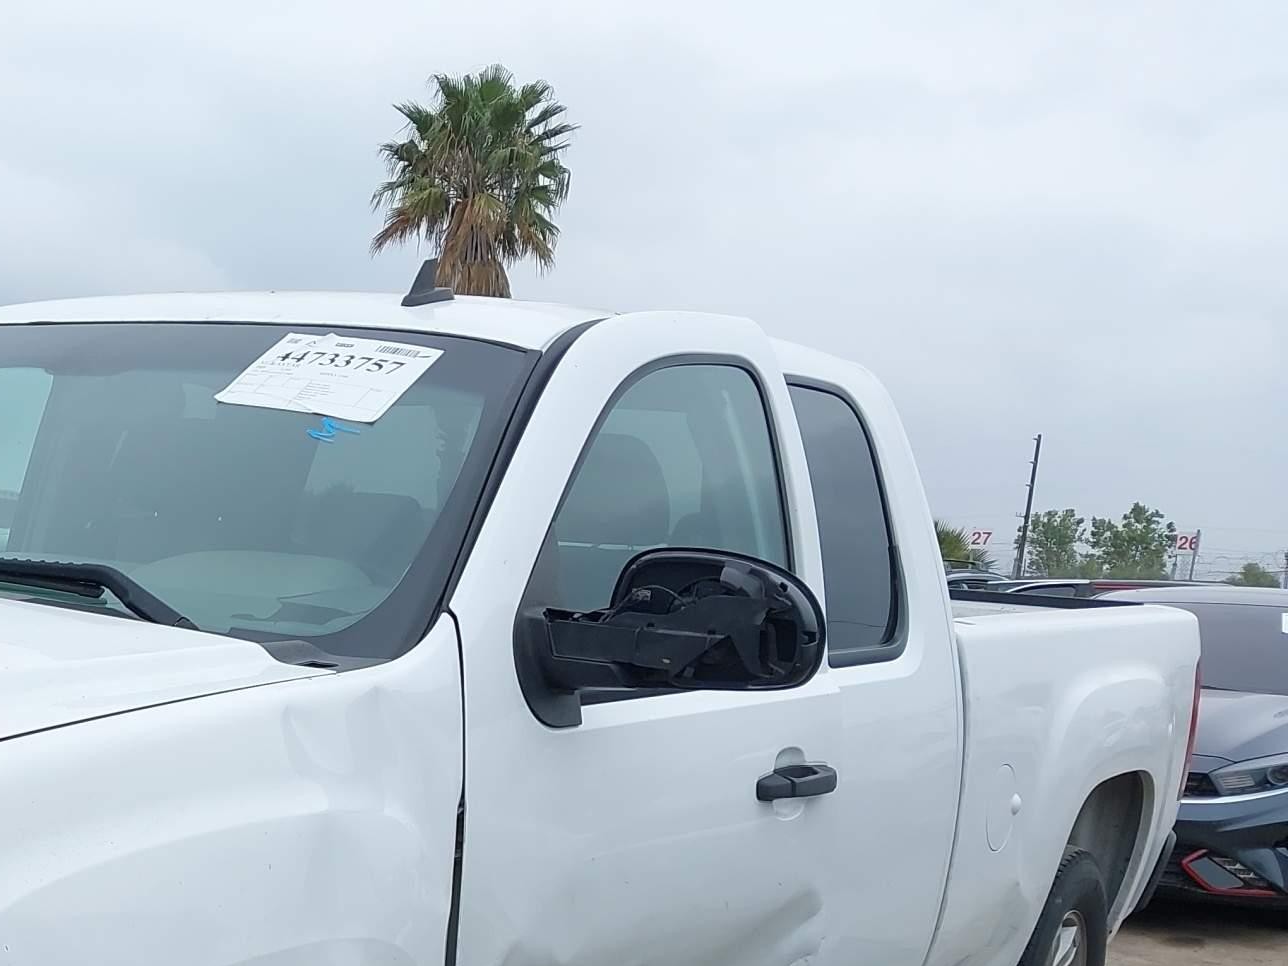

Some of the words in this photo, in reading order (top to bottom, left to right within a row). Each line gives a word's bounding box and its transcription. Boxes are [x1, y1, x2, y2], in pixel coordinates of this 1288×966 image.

[276, 350, 407, 375] 44733757
[971, 531, 992, 545] 27
[1177, 535, 1198, 551] 26
